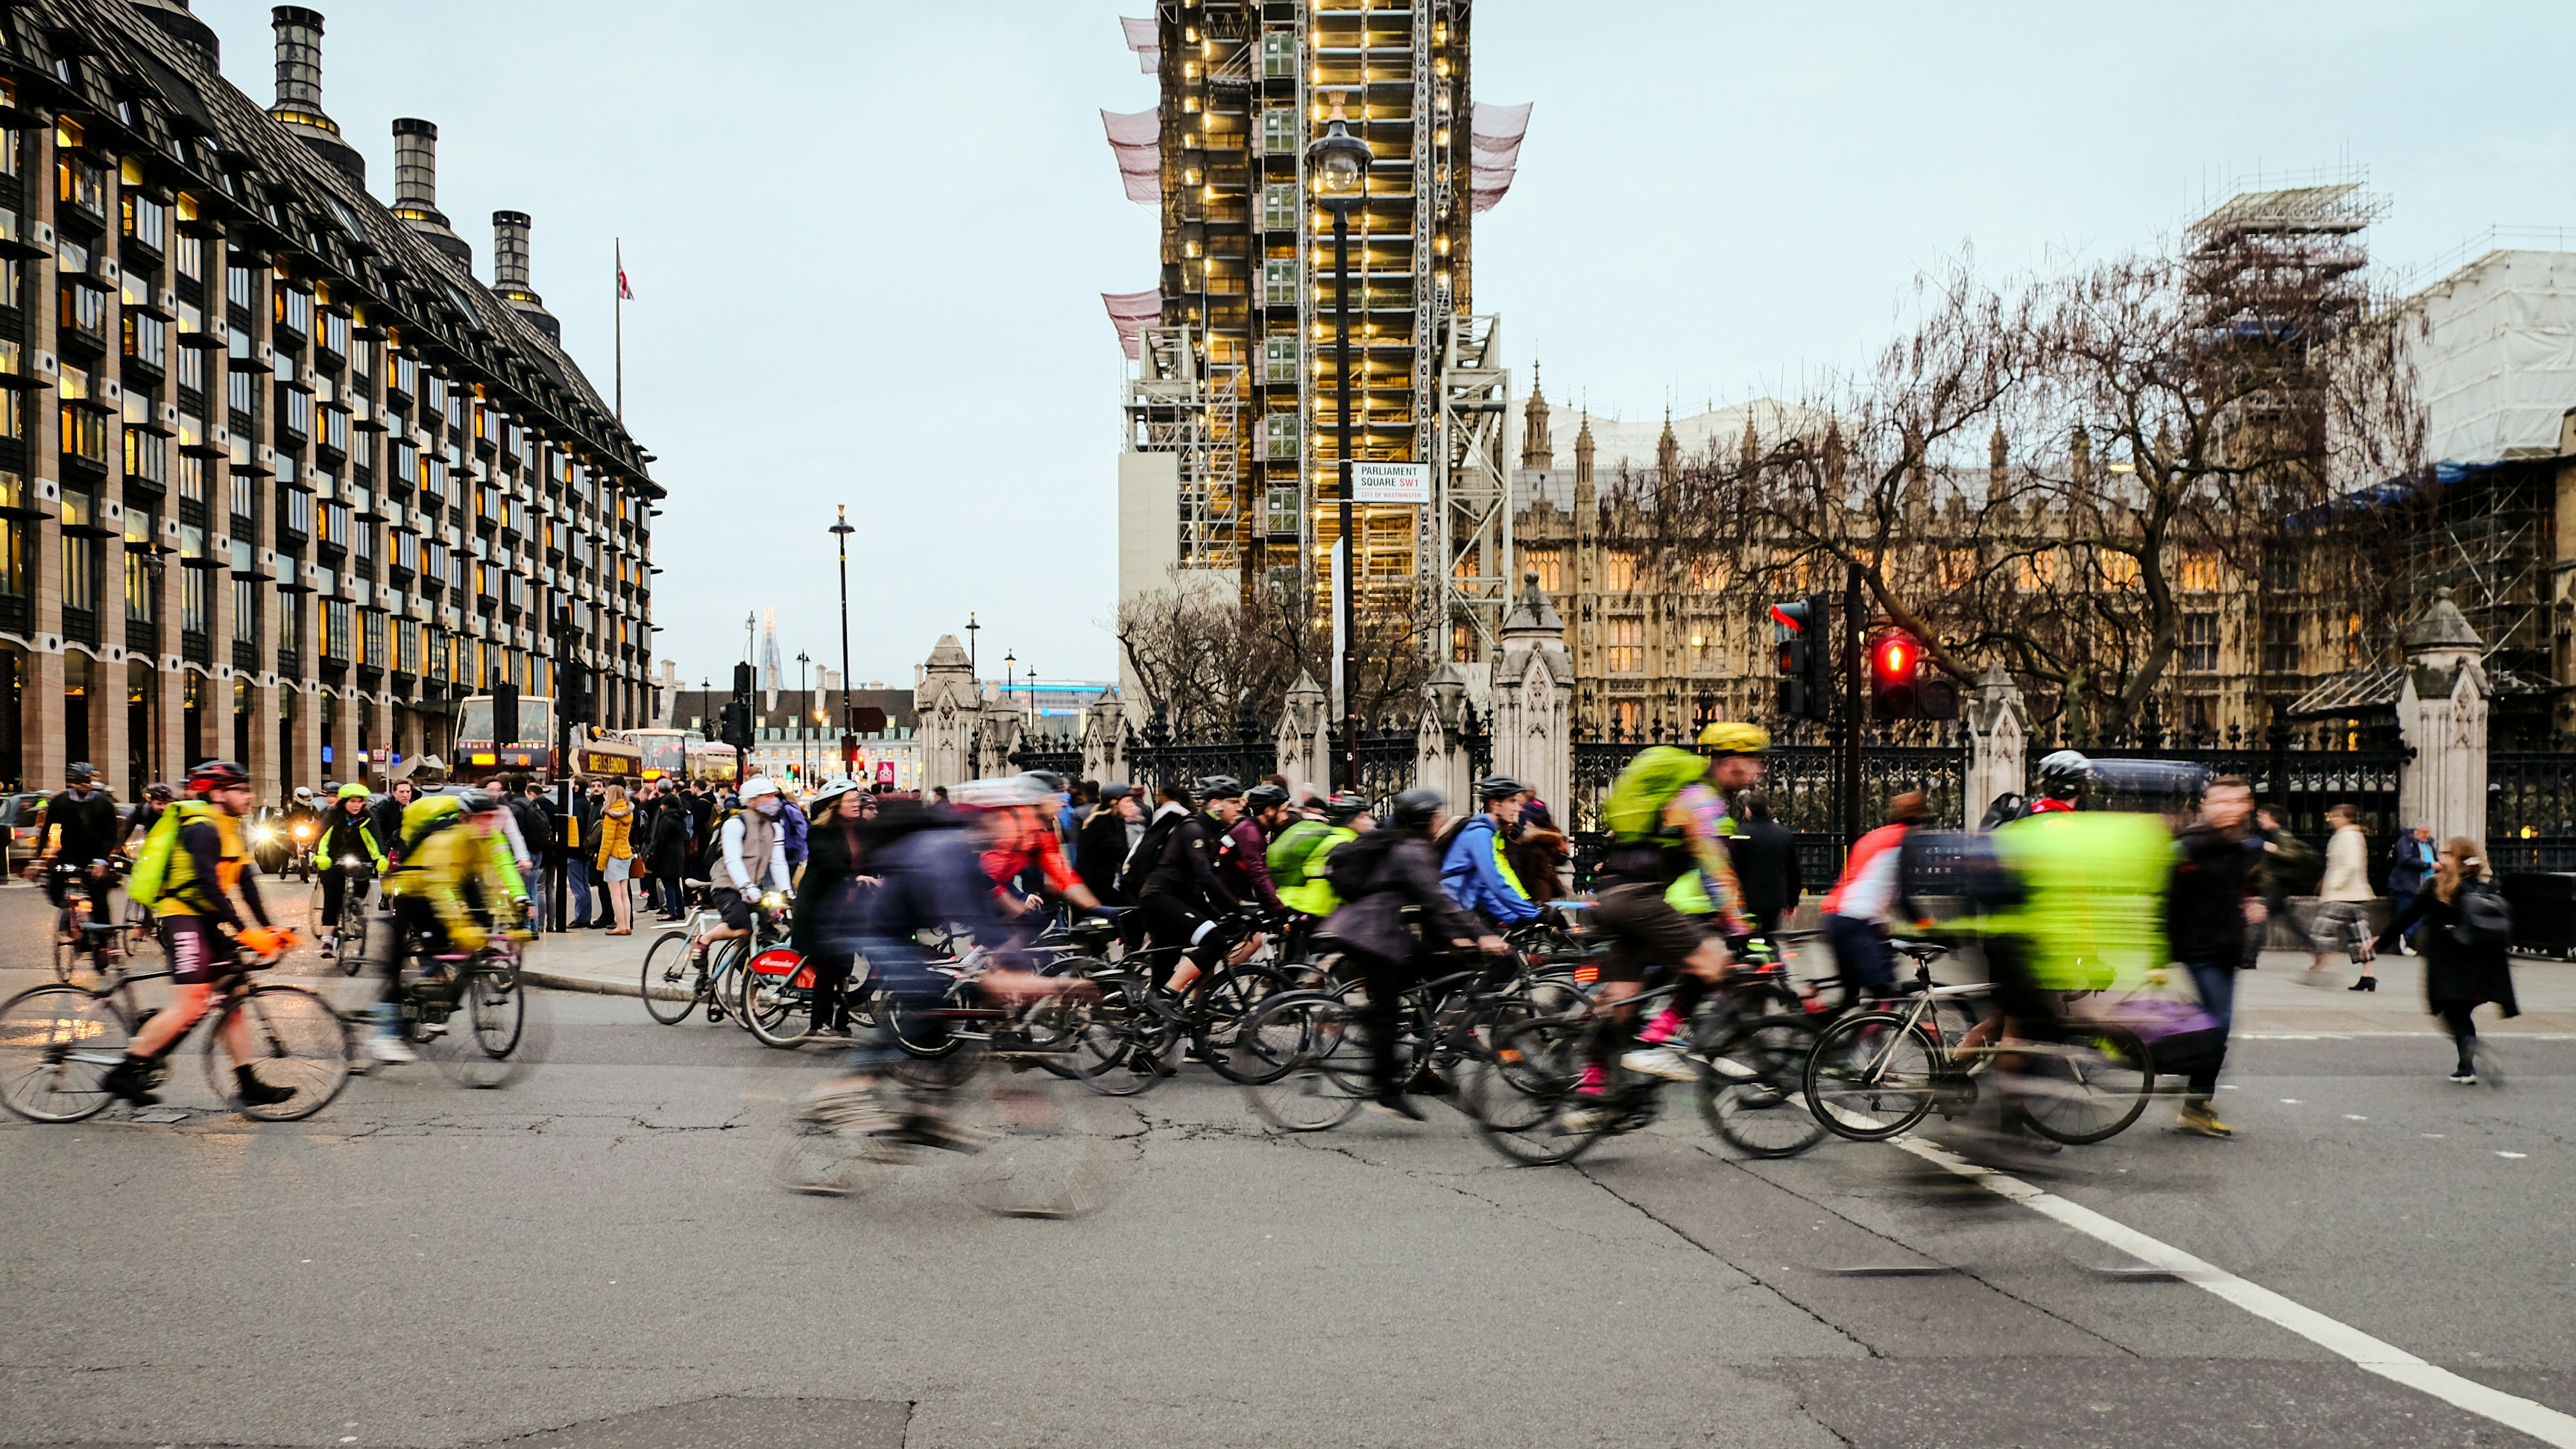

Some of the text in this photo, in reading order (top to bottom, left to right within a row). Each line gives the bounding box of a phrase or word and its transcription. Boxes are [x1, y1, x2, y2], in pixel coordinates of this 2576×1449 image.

[1361, 466, 1418, 476] PARLIAMENT
[1361, 477, 1418, 487] SQUARE SW1
[1347, 752, 1354, 761] 5
[607, 756, 628, 774] LONDON
